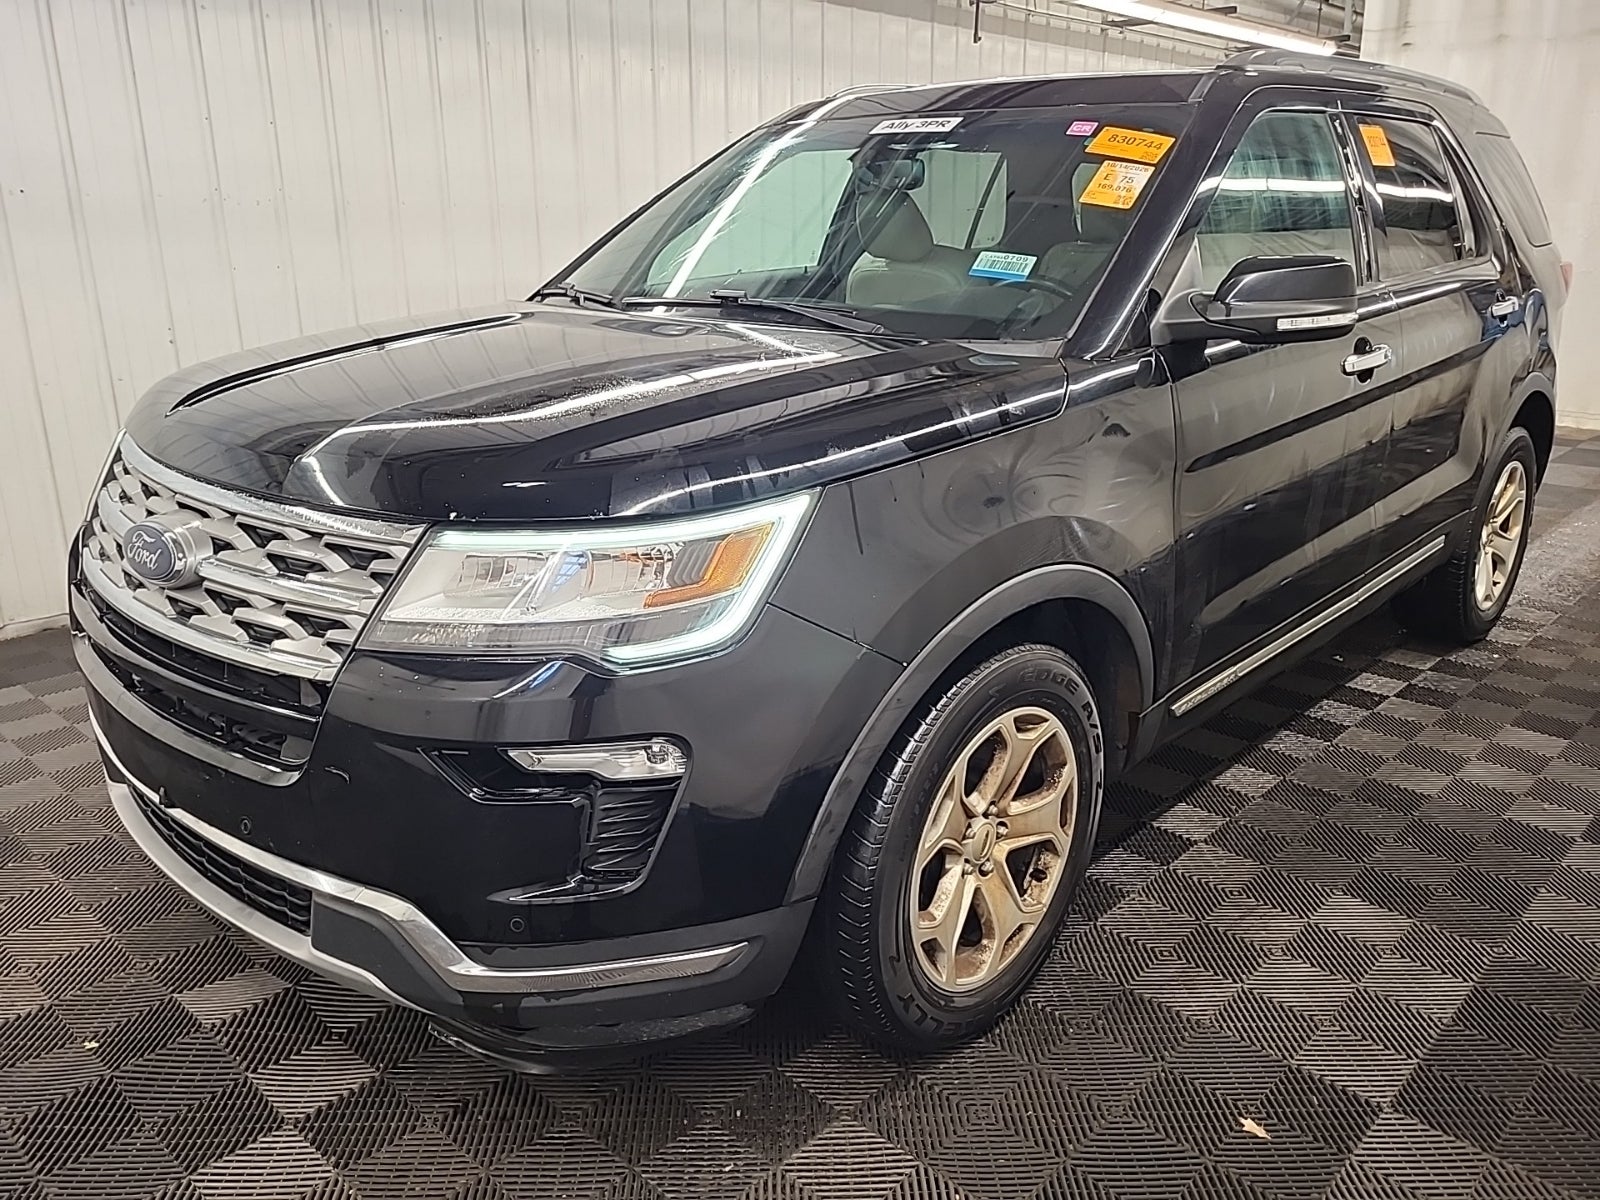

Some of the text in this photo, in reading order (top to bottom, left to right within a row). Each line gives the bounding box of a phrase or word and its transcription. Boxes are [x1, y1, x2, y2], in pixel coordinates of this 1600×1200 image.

[881, 120, 951, 130] Ally 3PR
[1073, 124, 1092, 132] CR
[1107, 133, 1164, 150] 830744
[1103, 173, 1136, 184] E 75
[127, 530, 162, 570] Ford
[1018, 665, 1080, 696] EDGE
